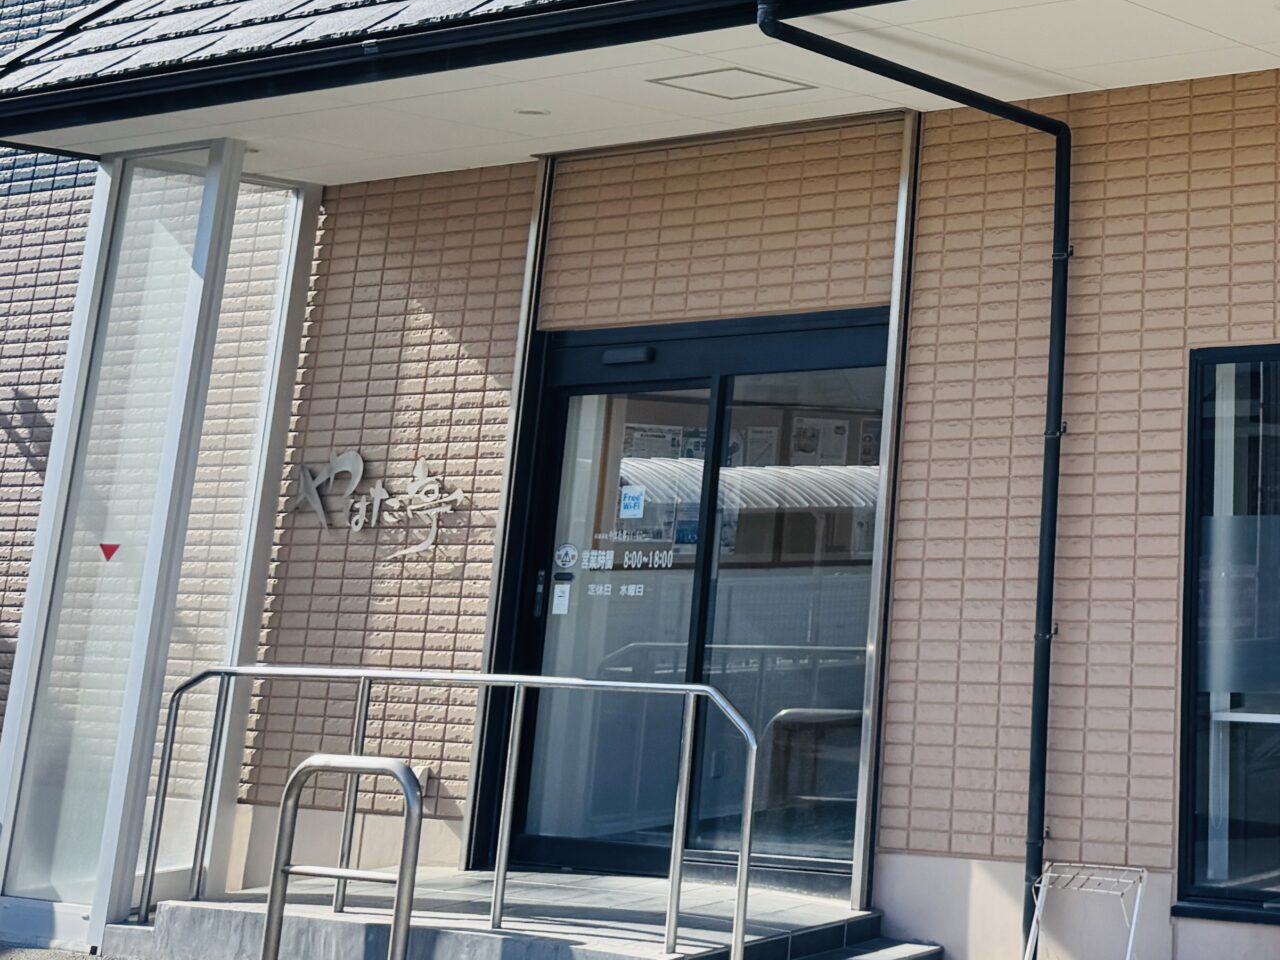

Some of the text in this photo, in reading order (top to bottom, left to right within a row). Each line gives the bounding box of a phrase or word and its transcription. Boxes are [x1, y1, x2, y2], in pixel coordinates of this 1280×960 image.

[623, 493, 641, 501] Free
[623, 502, 640, 510] Wi-Fi
[581, 550, 615, 570] 営業時間
[620, 584, 644, 596] 水曜日
